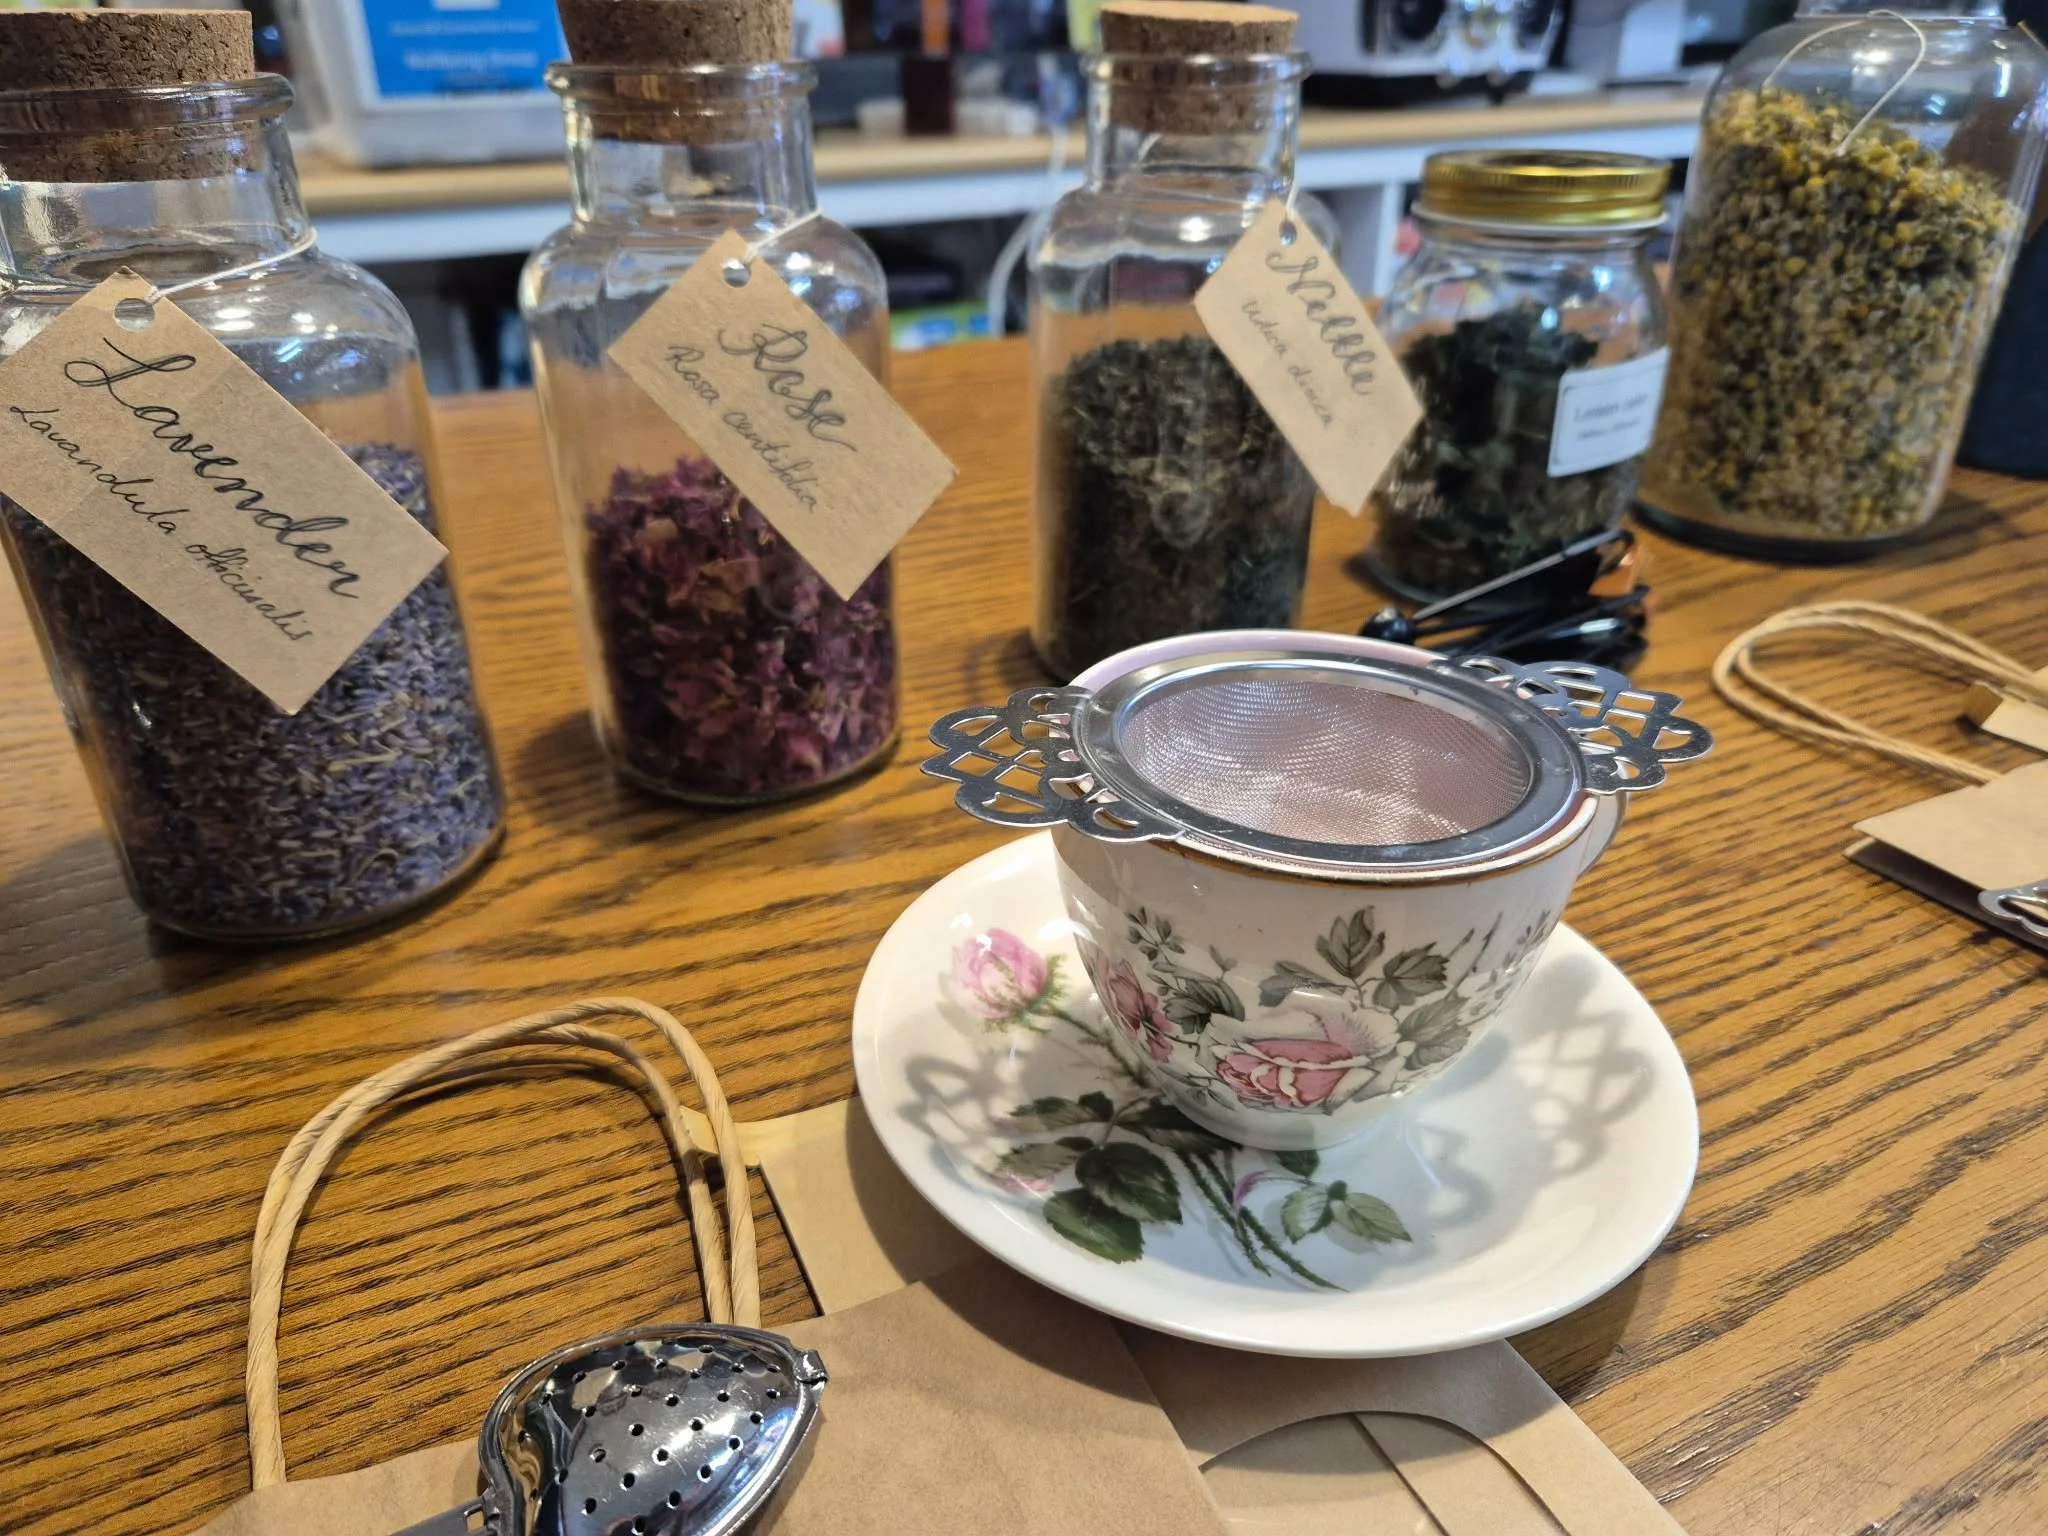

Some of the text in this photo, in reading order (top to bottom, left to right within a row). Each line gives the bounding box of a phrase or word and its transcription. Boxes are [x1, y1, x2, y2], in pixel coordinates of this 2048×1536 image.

[665, 346, 720, 405] Rosa
[717, 322, 857, 453] Rose
[1264, 251, 1376, 397] Nettle
[10, 404, 313, 642] Lavandula officinalis
[64, 337, 360, 599] Lavender
